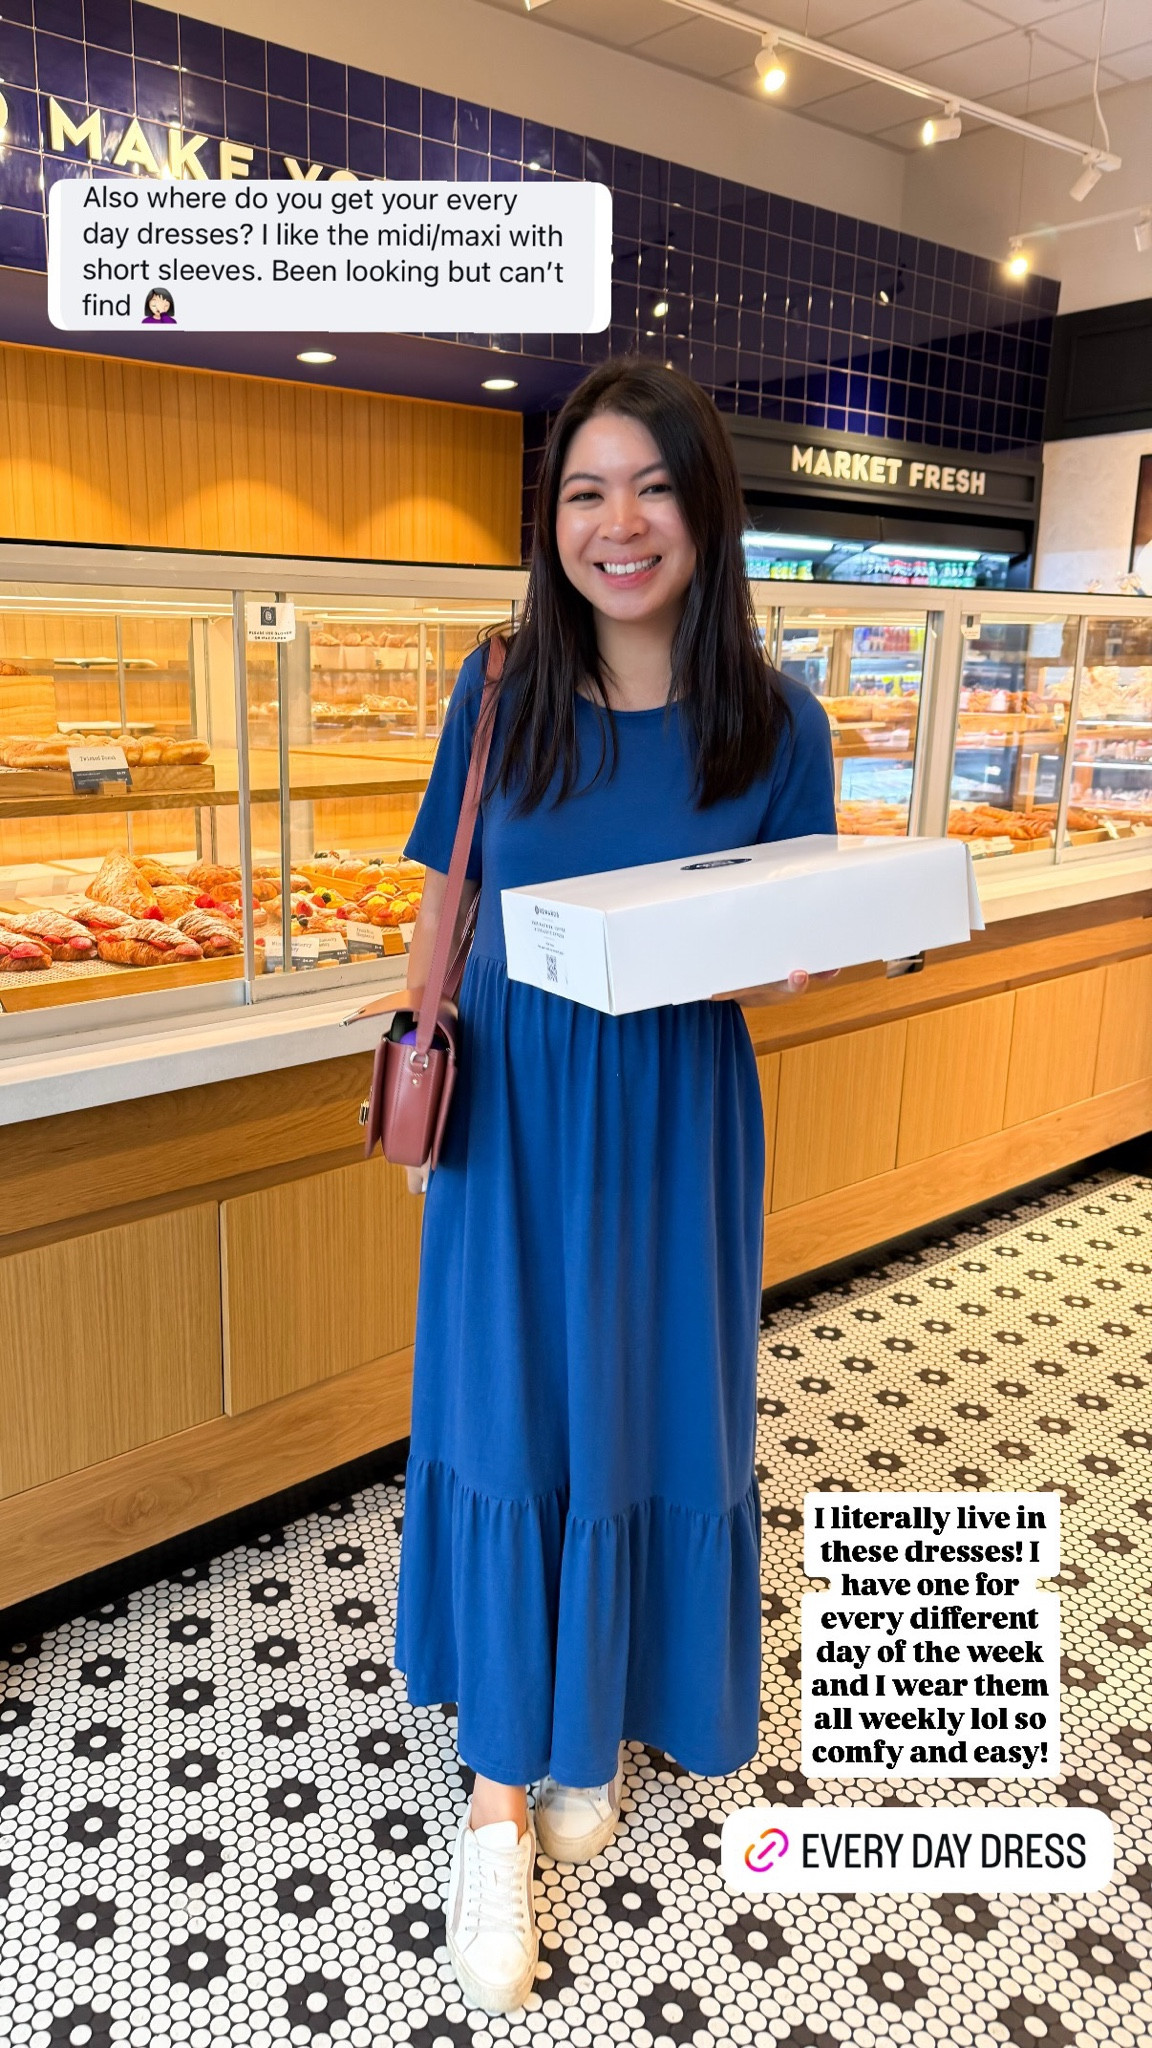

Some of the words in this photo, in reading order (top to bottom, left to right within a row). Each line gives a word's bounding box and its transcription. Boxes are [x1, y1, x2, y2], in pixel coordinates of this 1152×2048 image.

[49, 96, 254, 180] MAKE
[792, 445, 902, 485] MARKET
[910, 463, 986, 495] FRESH
